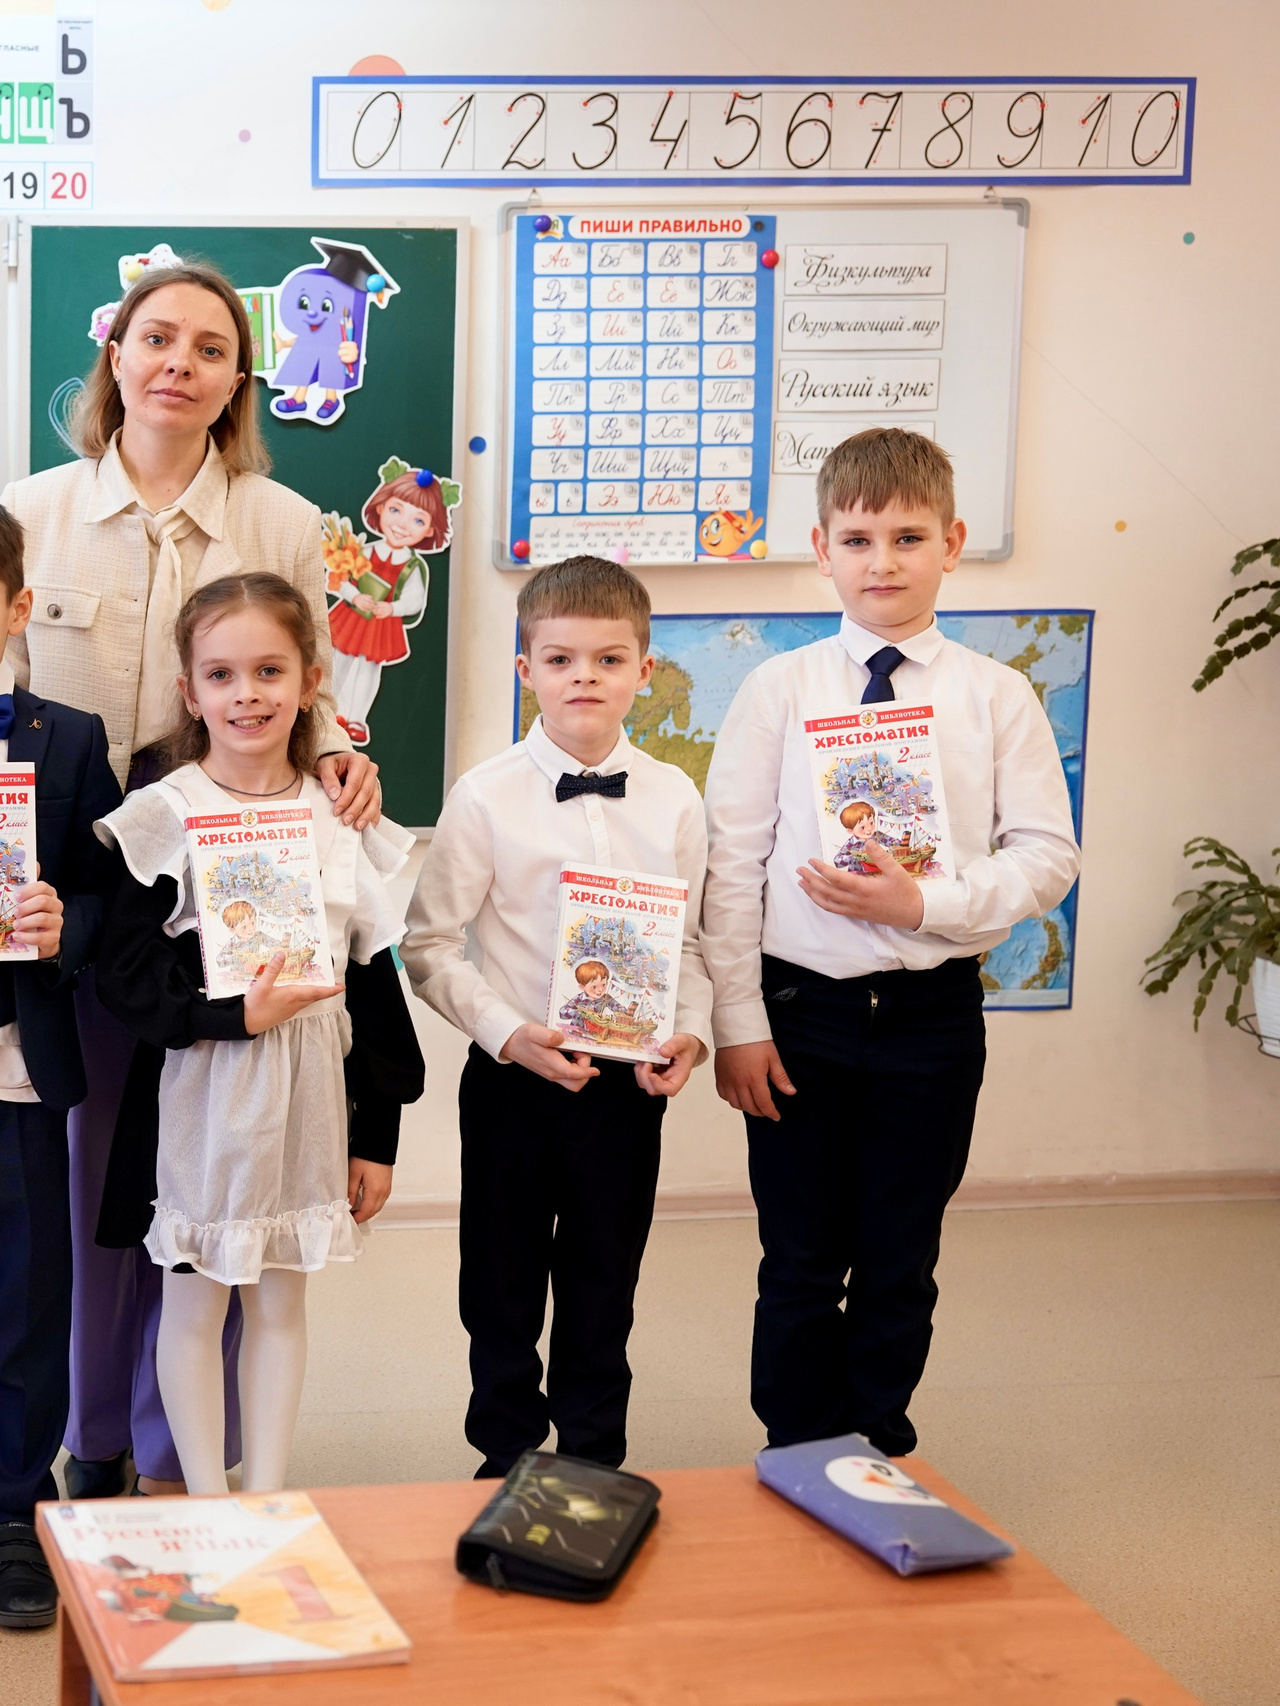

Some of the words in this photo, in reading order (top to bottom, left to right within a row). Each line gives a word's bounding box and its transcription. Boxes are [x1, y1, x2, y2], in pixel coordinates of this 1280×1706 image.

[62, 34, 87, 74] Ь
[20, 96, 54, 143] Щ
[59, 98, 90, 138] Ъ
[352, 91, 402, 168] 0
[440, 94, 474, 169] 1
[502, 93, 546, 170] 2
[573, 93, 619, 170] 3
[649, 93, 688, 170] 4
[714, 93, 762, 170] 5
[786, 92, 832, 170] 6
[861, 92, 903, 169] 7
[924, 92, 974, 169] 8
[997, 92, 1044, 169] 9
[1078, 91, 1180, 167] 10
[4, 172, 37, 199] 19
[52, 173, 86, 199] 20
[580, 220, 633, 233] ПИШИ
[639, 219, 743, 233] ПРАВИЛЬНО
[794, 248, 933, 293] Физкультура
[787, 311, 904, 338] Окружающий
[907, 319, 940, 337] мир
[781, 369, 873, 407] Русский
[878, 380, 934, 408] язык
[817, 719, 856, 728] ШКОЛЬНАЯ
[880, 710, 926, 720] БИБЛИОТЕКА
[814, 725, 930, 749] ХРЕСТОМАТИЯ
[897, 746, 910, 763] 2
[909, 752, 931, 760] класс
[200, 817, 237, 825] ШКОЛЬНАЯ
[261, 812, 304, 820] БИБЛИОТЕКА
[197, 826, 308, 846] ХРЕСТОМАТИЯ
[277, 847, 290, 864] 2
[289, 853, 311, 861] класс
[575, 875, 614, 887] ШКОЛЬНАЯ
[636, 886, 680, 897] БИБЛИОТЕКА
[569, 889, 679, 917] ХРЕСТОМАТИЯ
[641, 921, 657, 936] 2
[654, 930, 676, 939] класс
